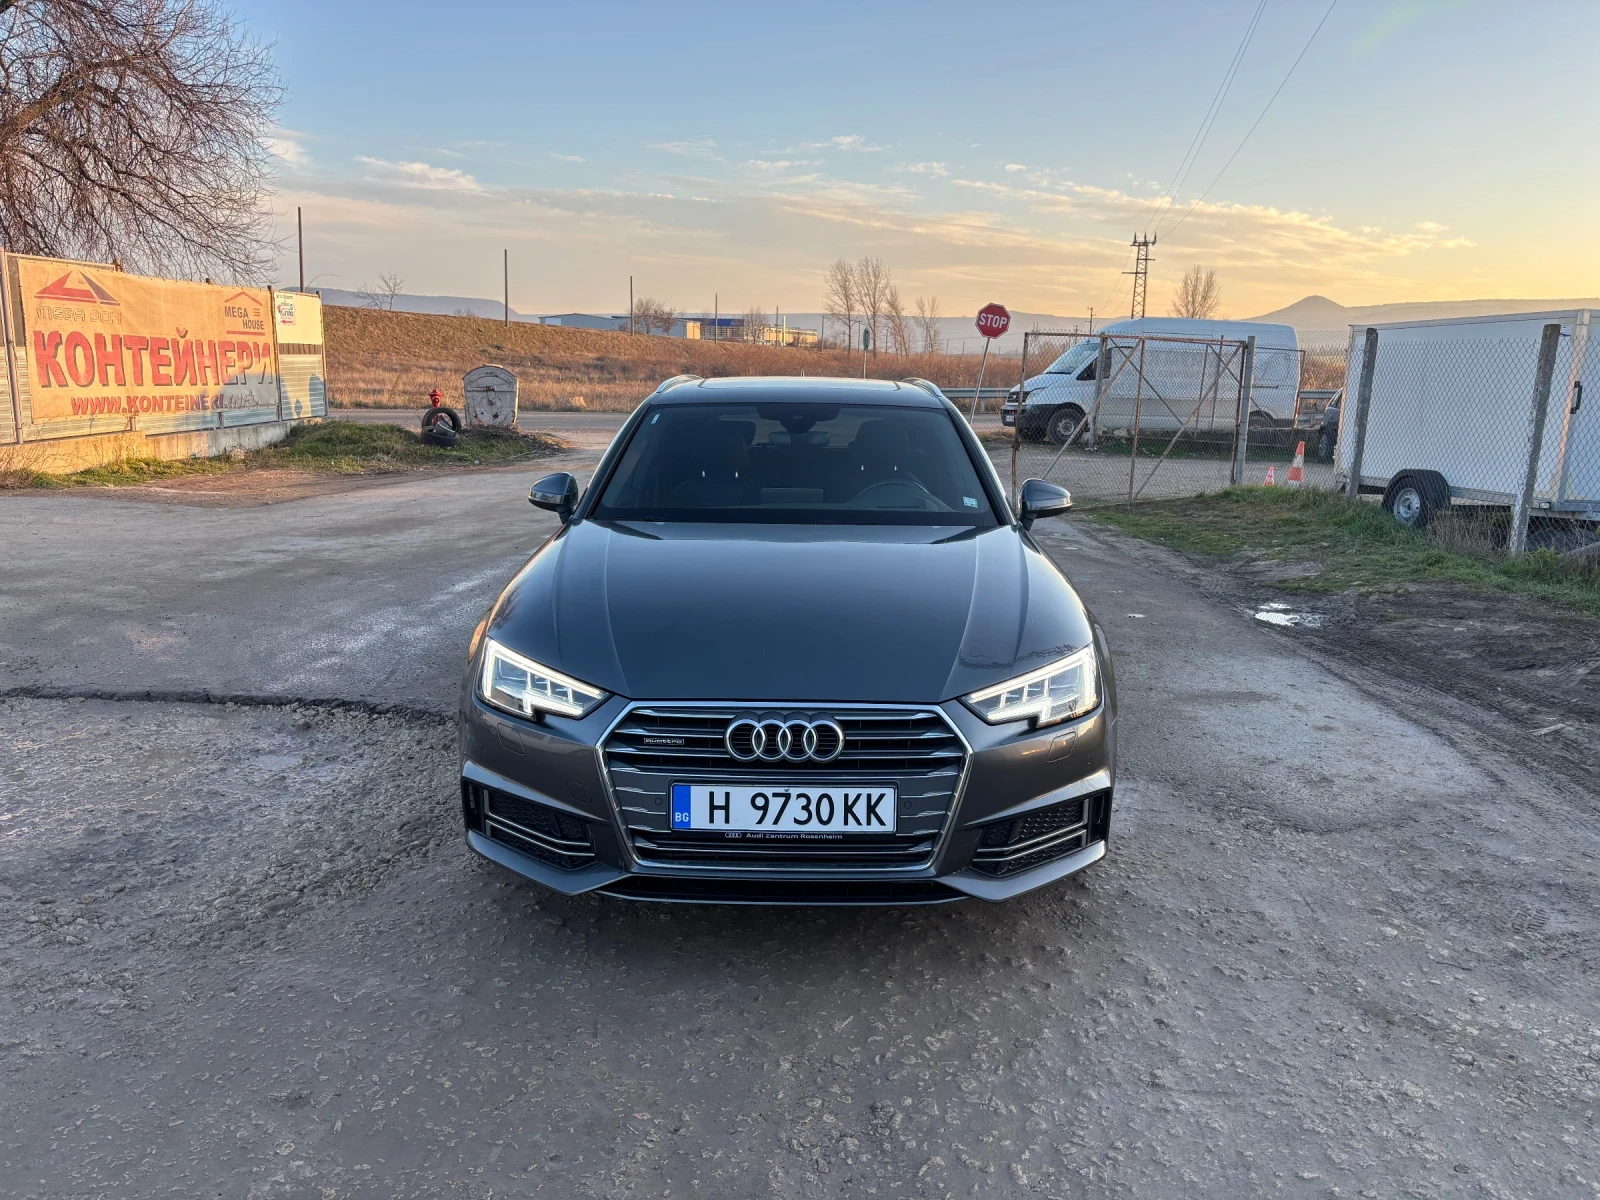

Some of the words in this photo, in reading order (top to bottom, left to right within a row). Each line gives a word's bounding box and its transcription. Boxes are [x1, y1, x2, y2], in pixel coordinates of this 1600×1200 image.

[36, 306, 86, 322] MEGA
[224, 305, 249, 319] MEGA
[242, 318, 265, 331] HOUSE
[979, 313, 1007, 328] STOP
[33, 327, 273, 387] КОНТЕЙНЕРИ
[709, 791, 730, 824] H
[750, 792, 835, 826] 9730
[843, 793, 887, 827] KK
[674, 812, 690, 823] BG
